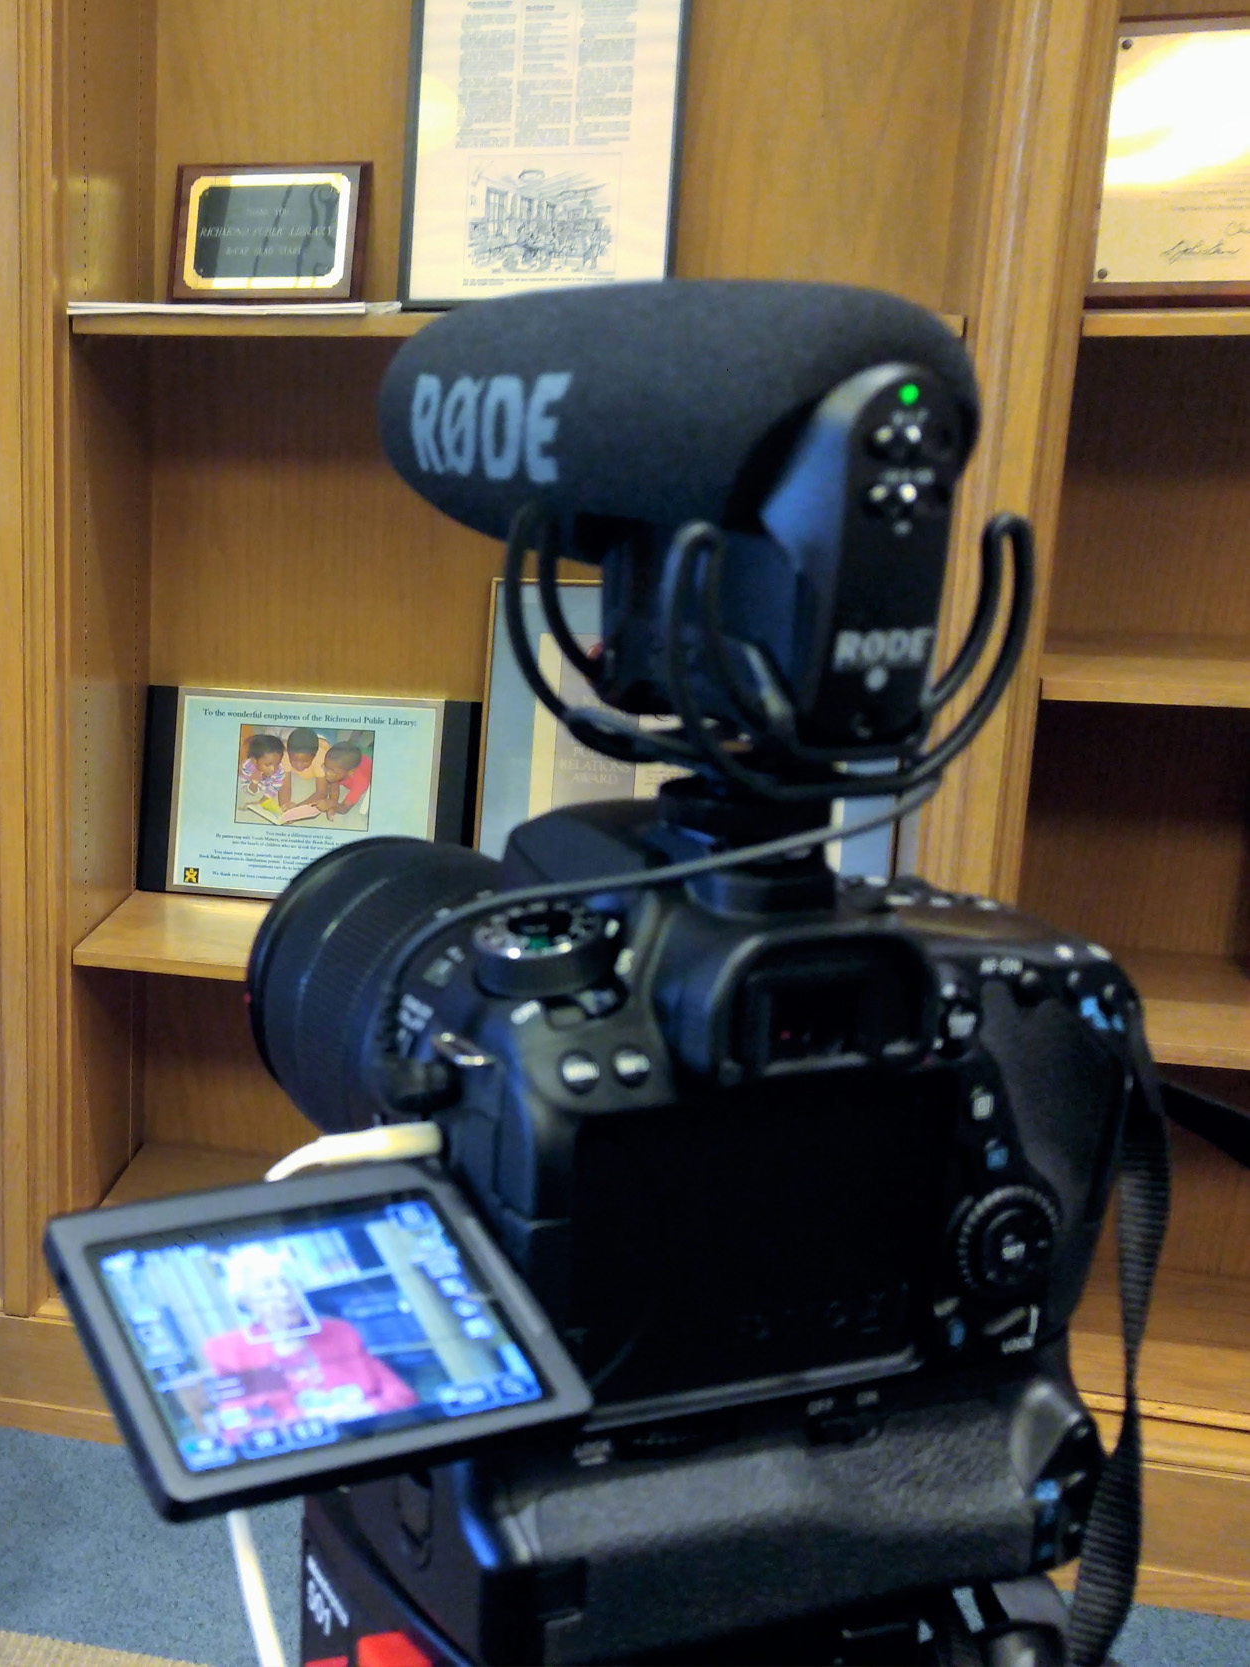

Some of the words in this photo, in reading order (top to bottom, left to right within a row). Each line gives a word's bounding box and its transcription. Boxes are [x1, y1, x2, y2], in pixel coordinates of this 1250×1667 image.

[202, 708, 213, 716] To
[214, 709, 225, 717] the
[227, 710, 262, 719] wonderful
[263, 712, 300, 721] employees
[311, 714, 323, 722] the
[324, 714, 362, 724] Richmond
[363, 716, 385, 725] Public
[388, 717, 417, 727] Library:
